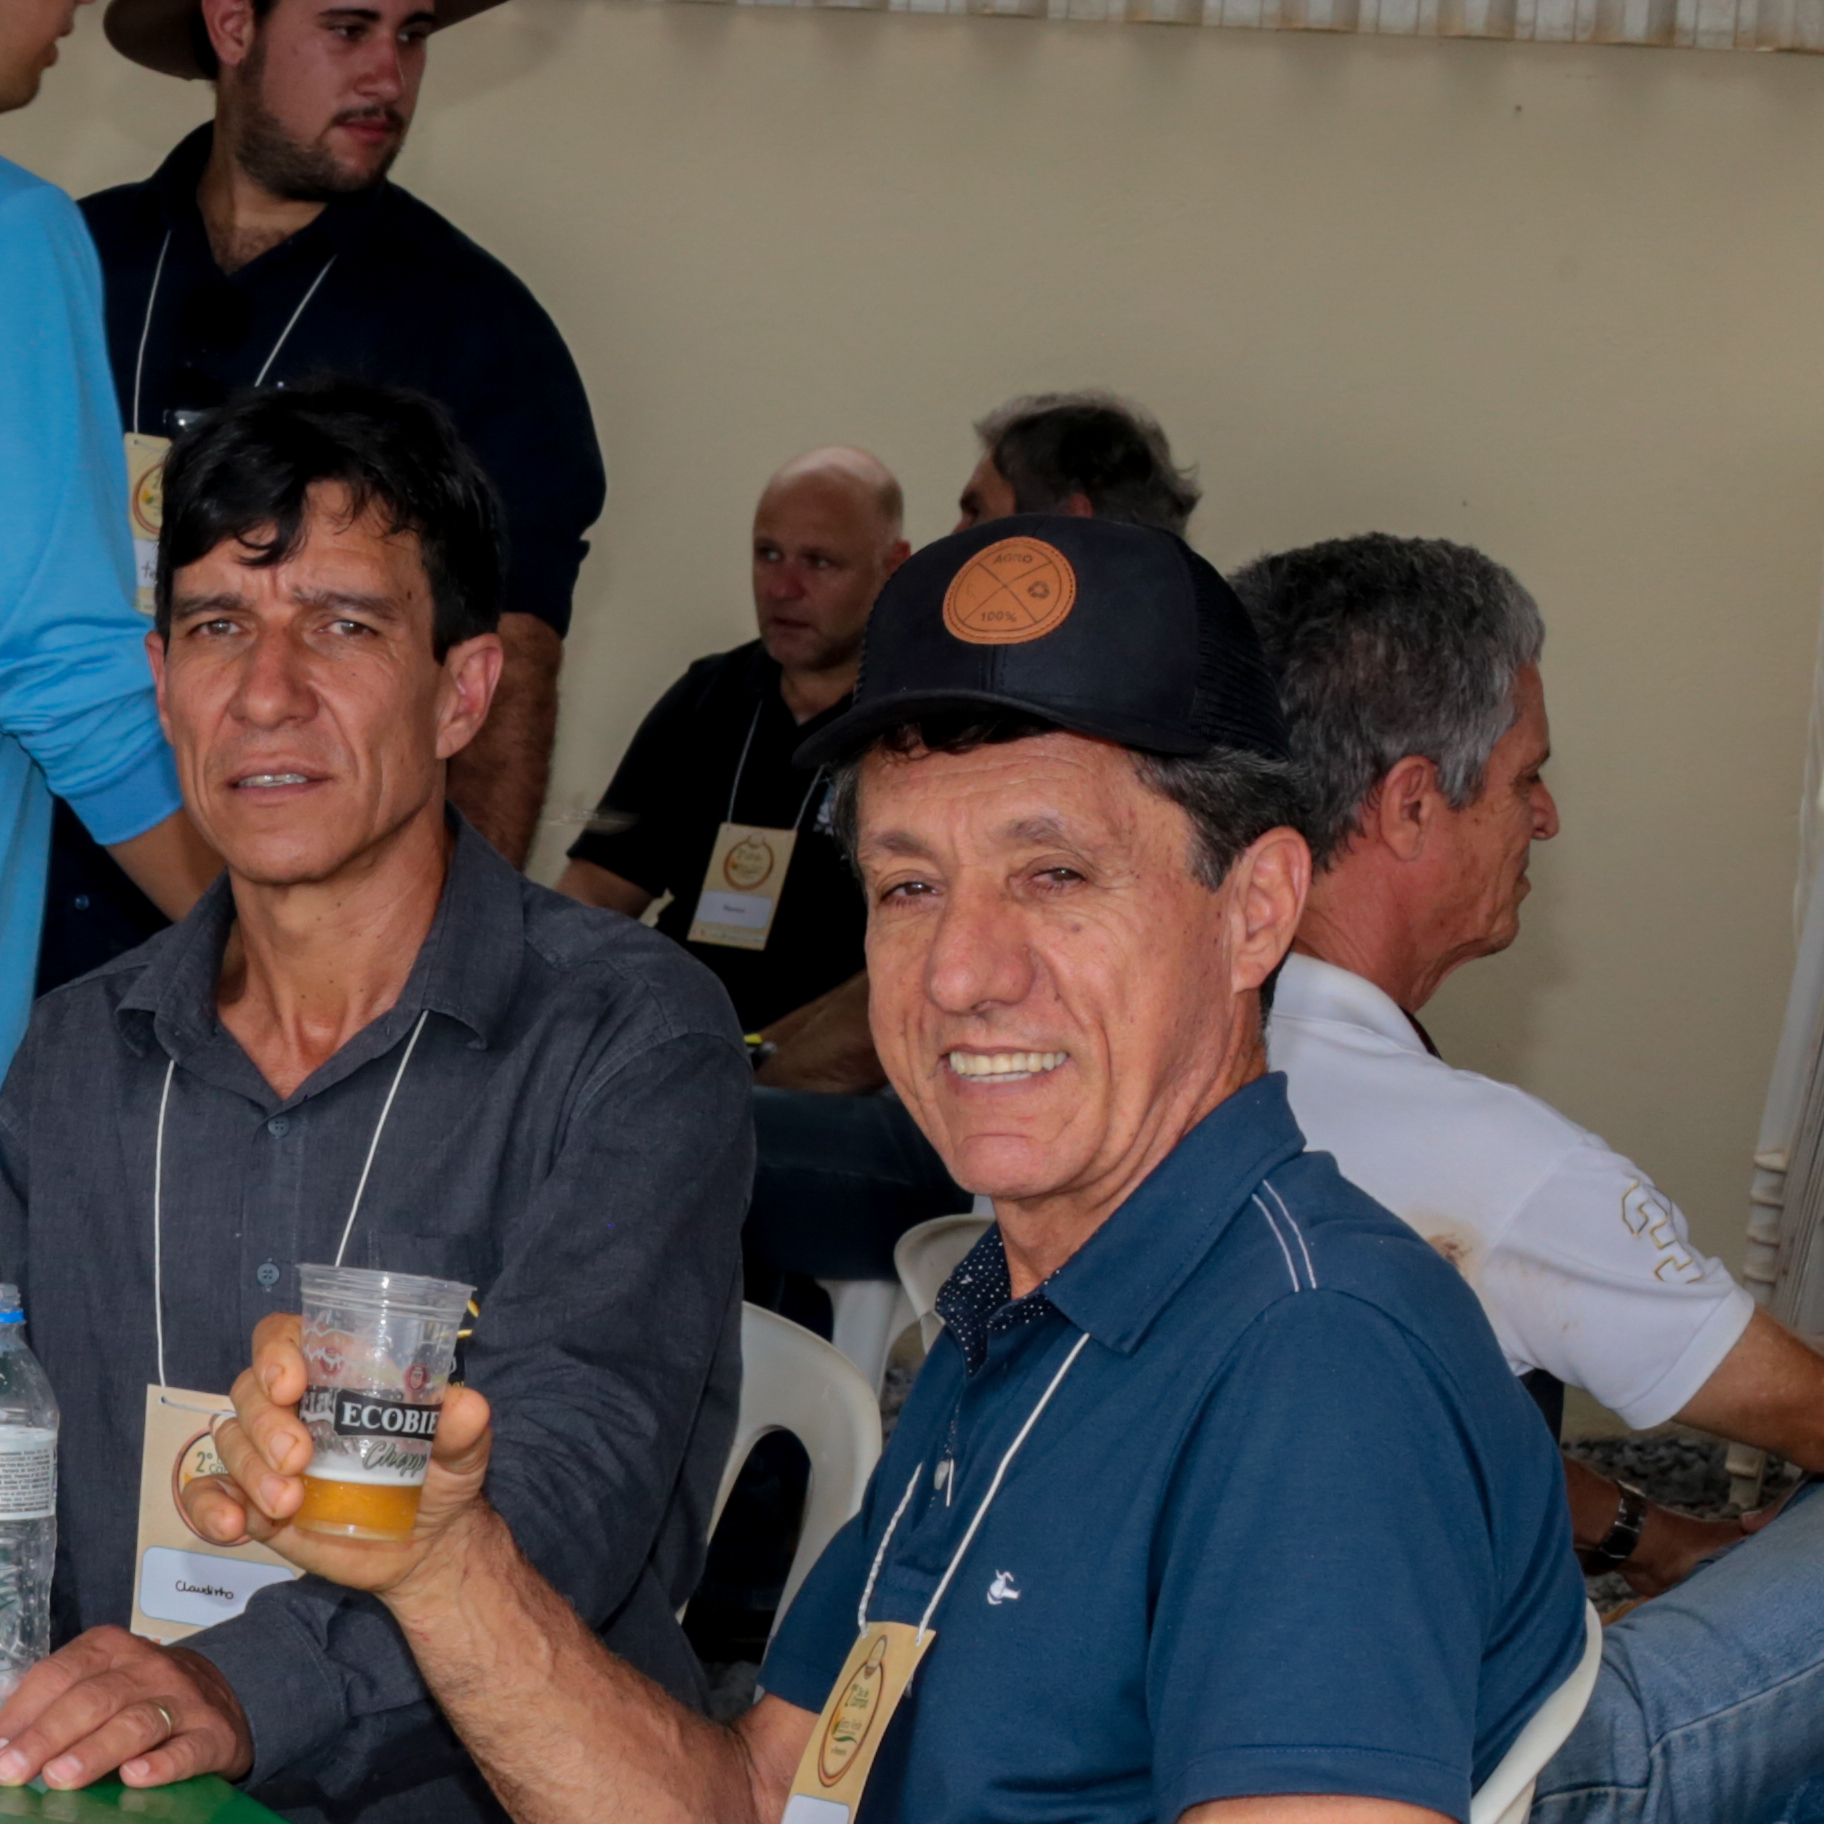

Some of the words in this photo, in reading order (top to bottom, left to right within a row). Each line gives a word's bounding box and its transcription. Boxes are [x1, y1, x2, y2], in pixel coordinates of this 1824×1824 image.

[994, 553, 1033, 565] AGRO
[981, 611, 1018, 622] 100%
[341, 1401, 442, 1434] ECOBIE
